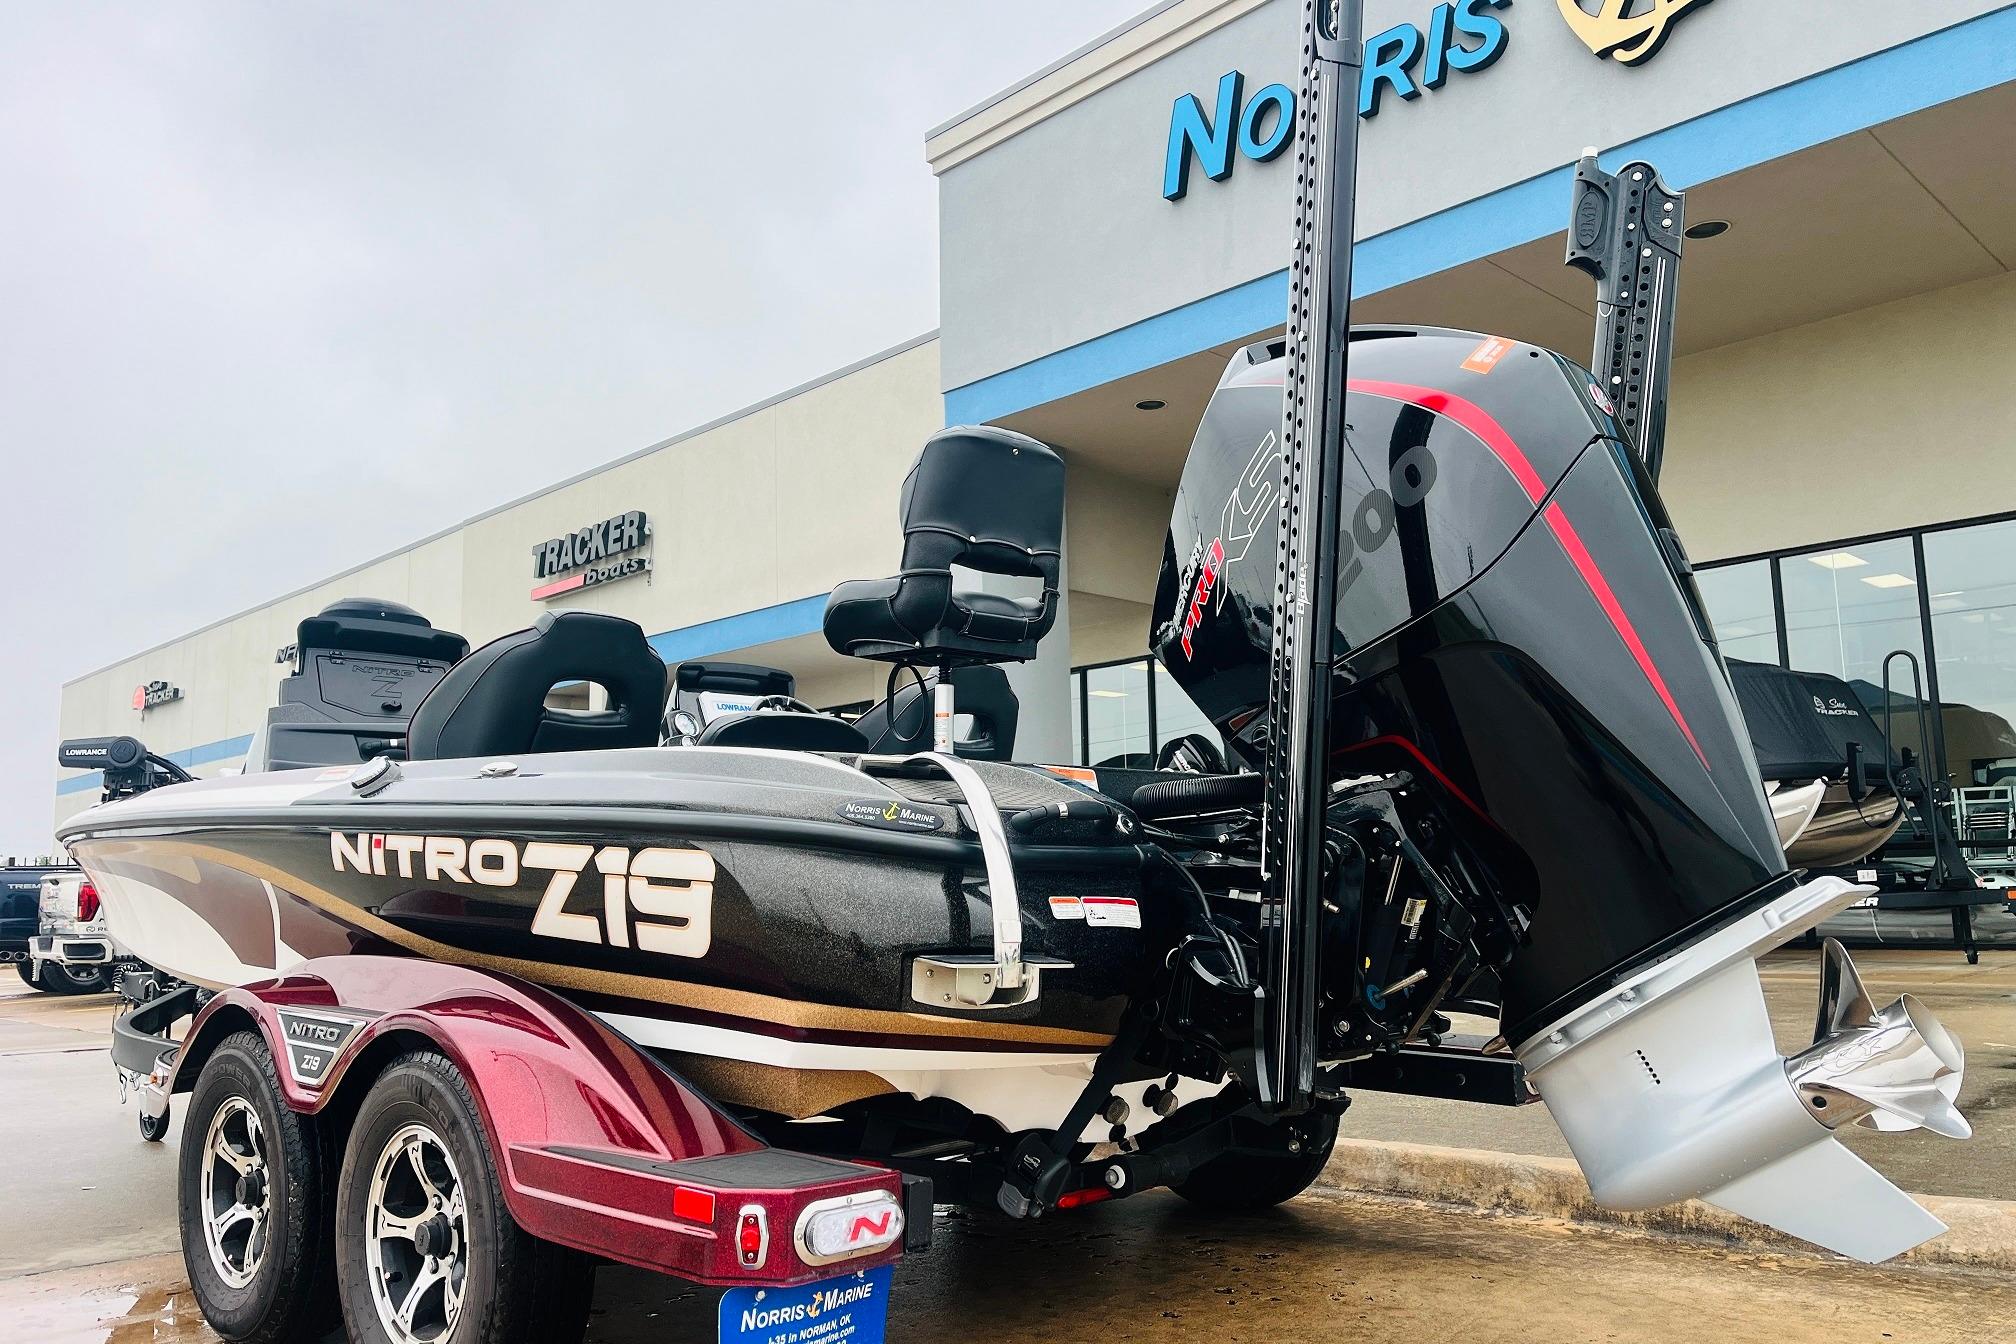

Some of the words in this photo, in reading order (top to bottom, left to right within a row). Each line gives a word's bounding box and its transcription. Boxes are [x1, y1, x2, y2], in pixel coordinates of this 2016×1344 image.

[1163, 0, 1513, 202] NORIS
[532, 510, 646, 578] TRACKER
[585, 558, 642, 585] boats
[1181, 537, 1225, 662] PRO
[352, 664, 415, 677] NITRO
[370, 675, 403, 698] Z
[1815, 707, 1859, 716] TRACKER
[65, 748, 107, 756] LOWRANCE
[845, 803, 881, 815] NORRIS
[900, 808, 935, 823] MARINE
[330, 831, 519, 887] NITRO
[521, 842, 716, 959] Z19
[289, 1021, 341, 1041] NITRO
[300, 1054, 320, 1070] Z19
[740, 1305, 805, 1332] NORRIS
[823, 1282, 873, 1312] MARINE
[840, 1313, 851, 1326] OK
